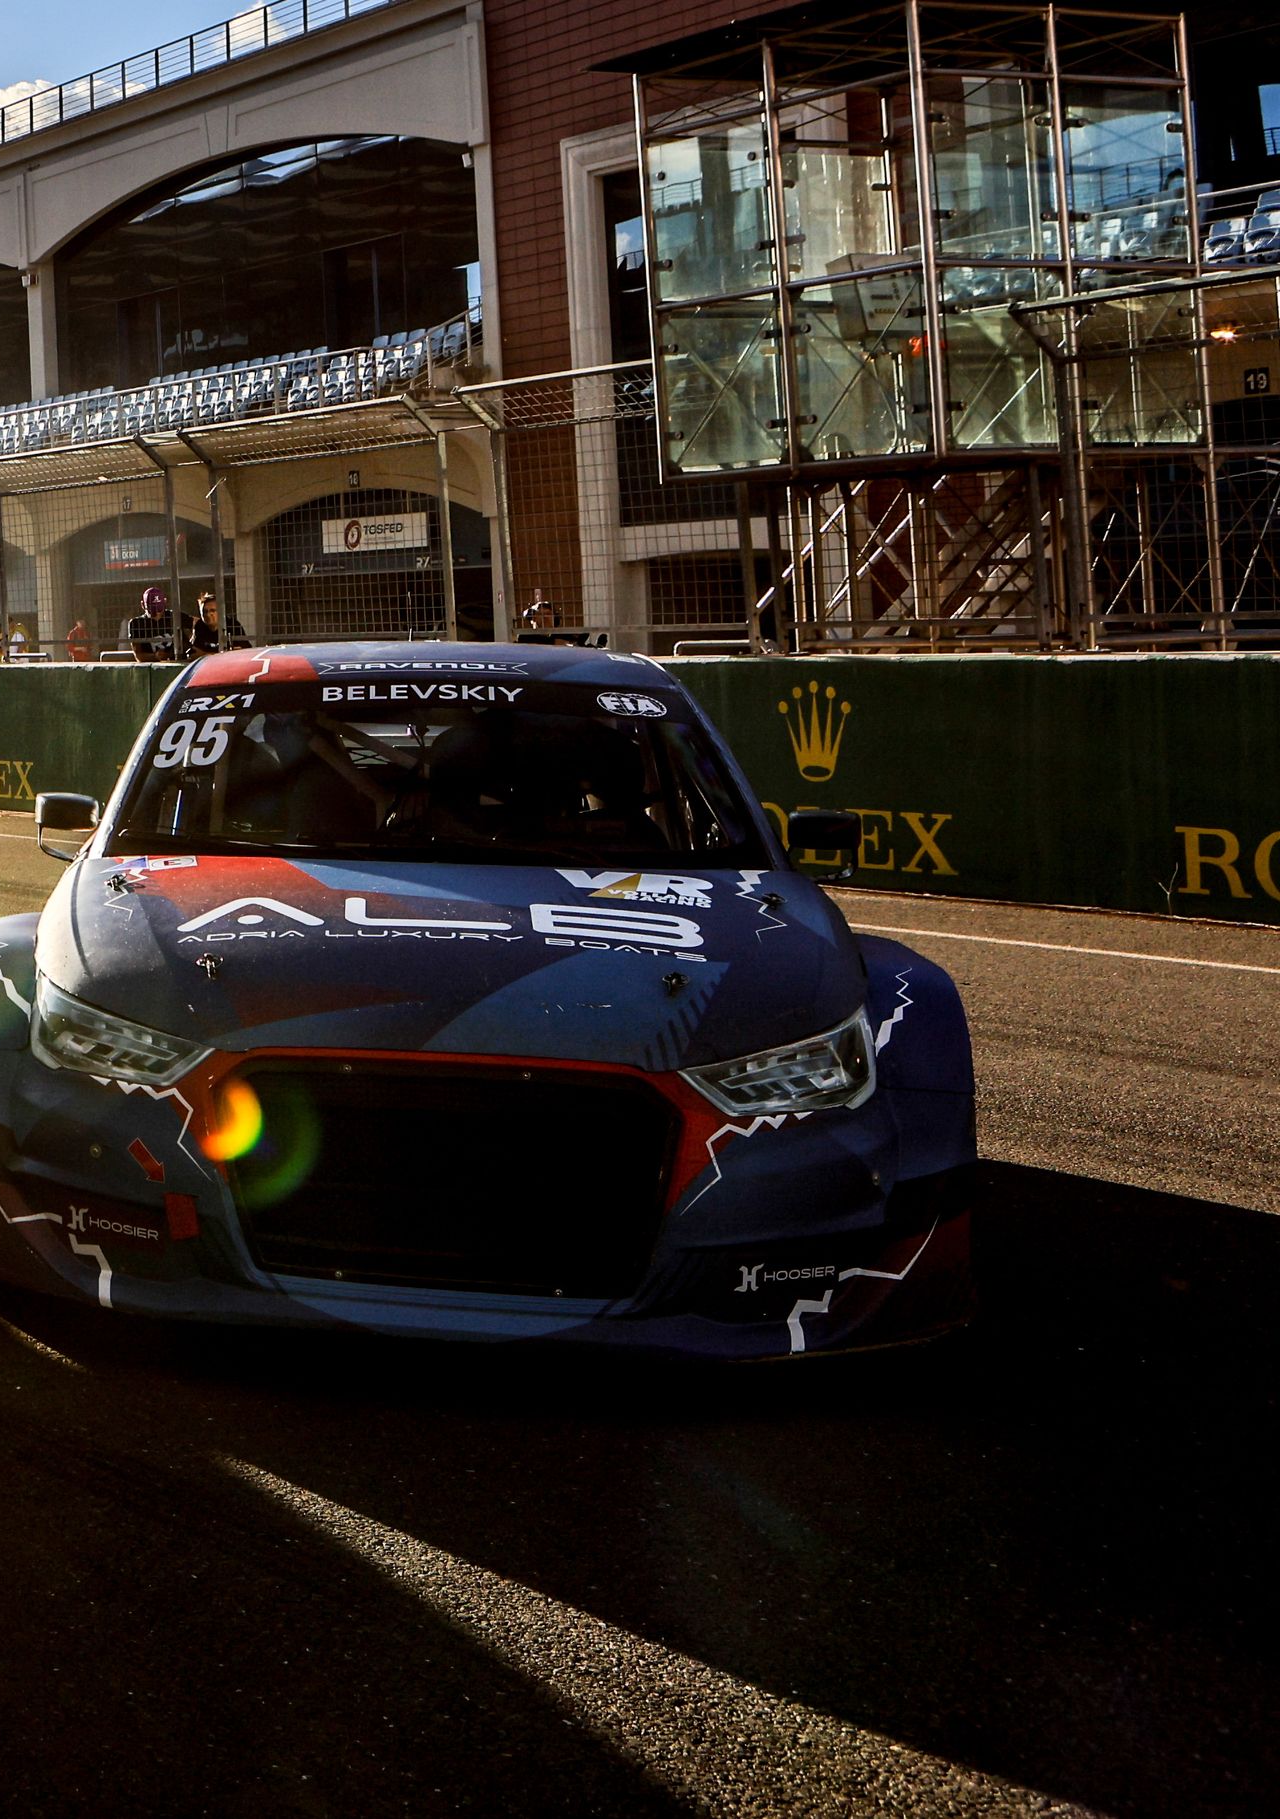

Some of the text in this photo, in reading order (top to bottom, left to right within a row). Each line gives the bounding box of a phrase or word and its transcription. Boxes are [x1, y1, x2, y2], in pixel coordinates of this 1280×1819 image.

[363, 522, 403, 535] TOSFED
[188, 693, 255, 713] RX1
[322, 684, 524, 703] BELEVSKIY
[153, 716, 235, 769] 95
[553, 868, 715, 900] VR
[177, 929, 708, 962] ADRIA LUXURY BOATS
[88, 1217, 159, 1241] HOOSIER
[763, 1266, 836, 1281] HOOSIER
